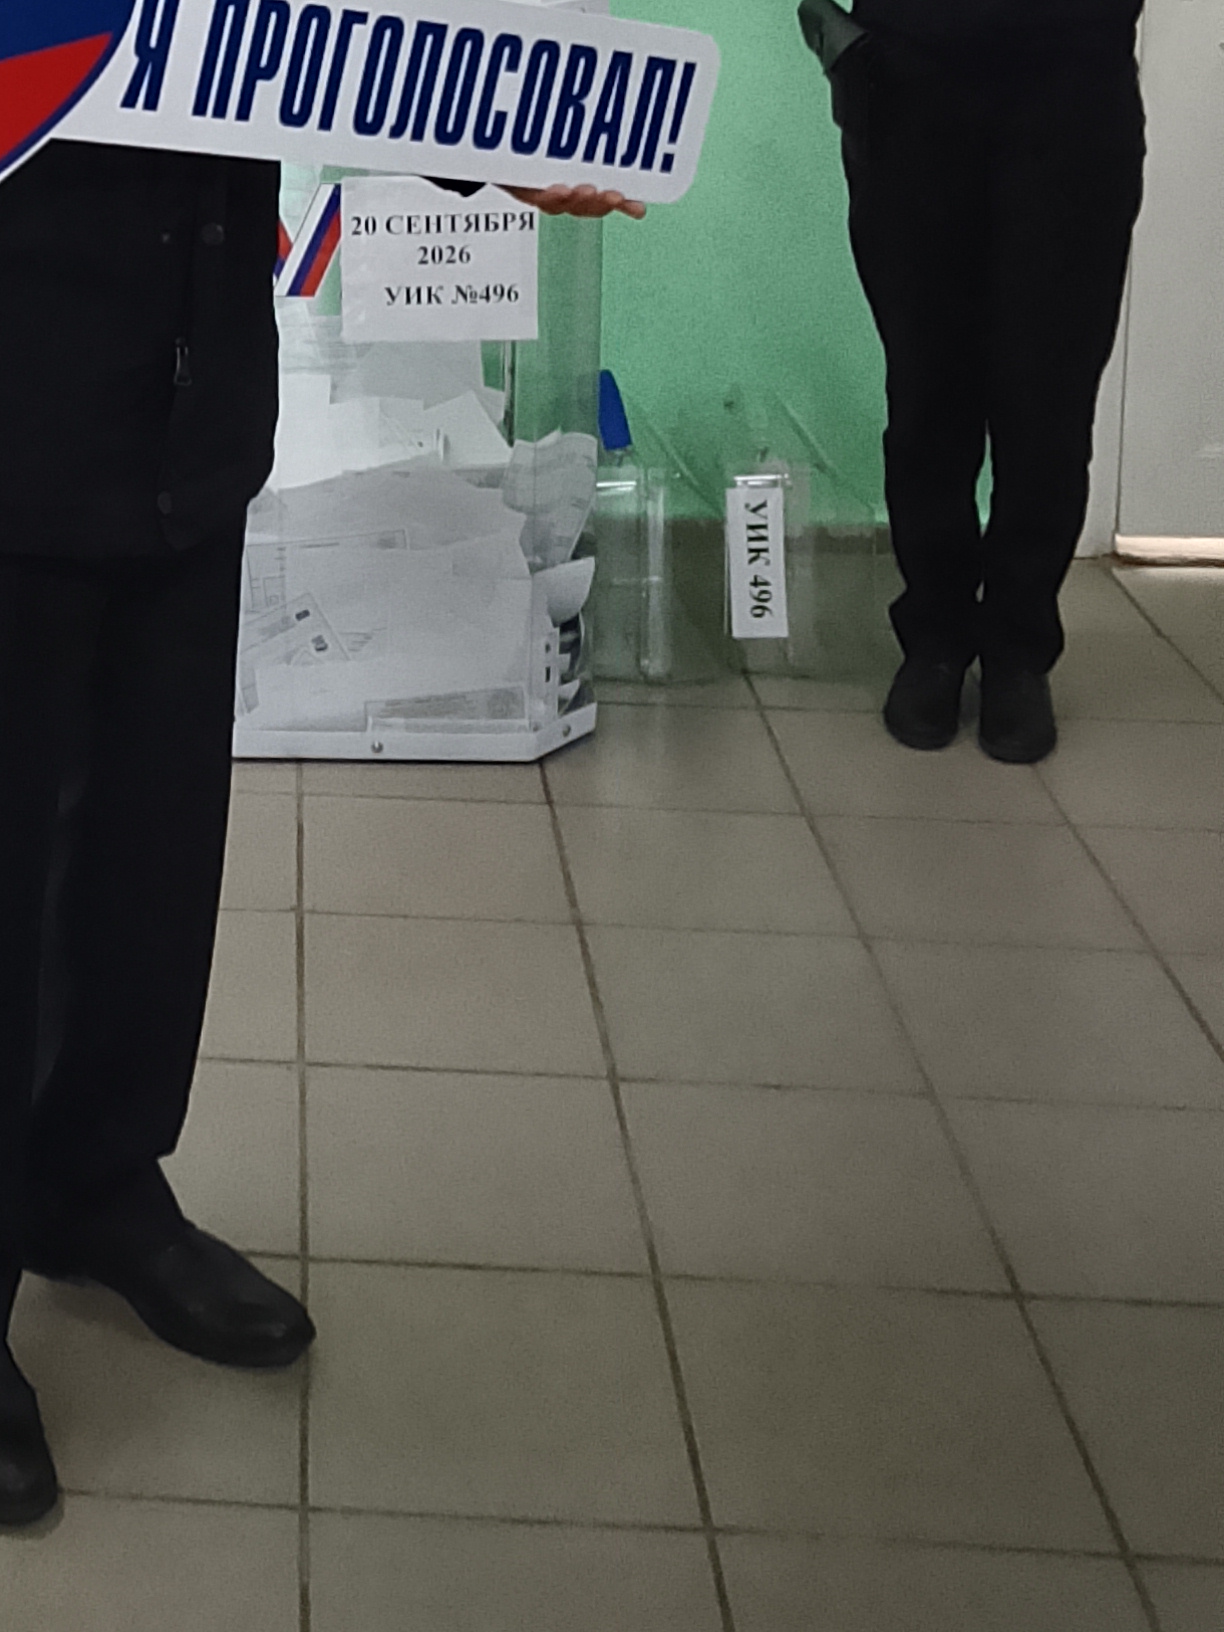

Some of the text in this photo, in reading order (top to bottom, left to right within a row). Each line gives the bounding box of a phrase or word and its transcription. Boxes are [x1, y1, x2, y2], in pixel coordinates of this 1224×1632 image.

[351, 212, 535, 235] 20 СЕНТЯБРЯ
[418, 245, 471, 265] 2026
[385, 284, 519, 306] УИК №496
[744, 499, 773, 619] УИК 496
